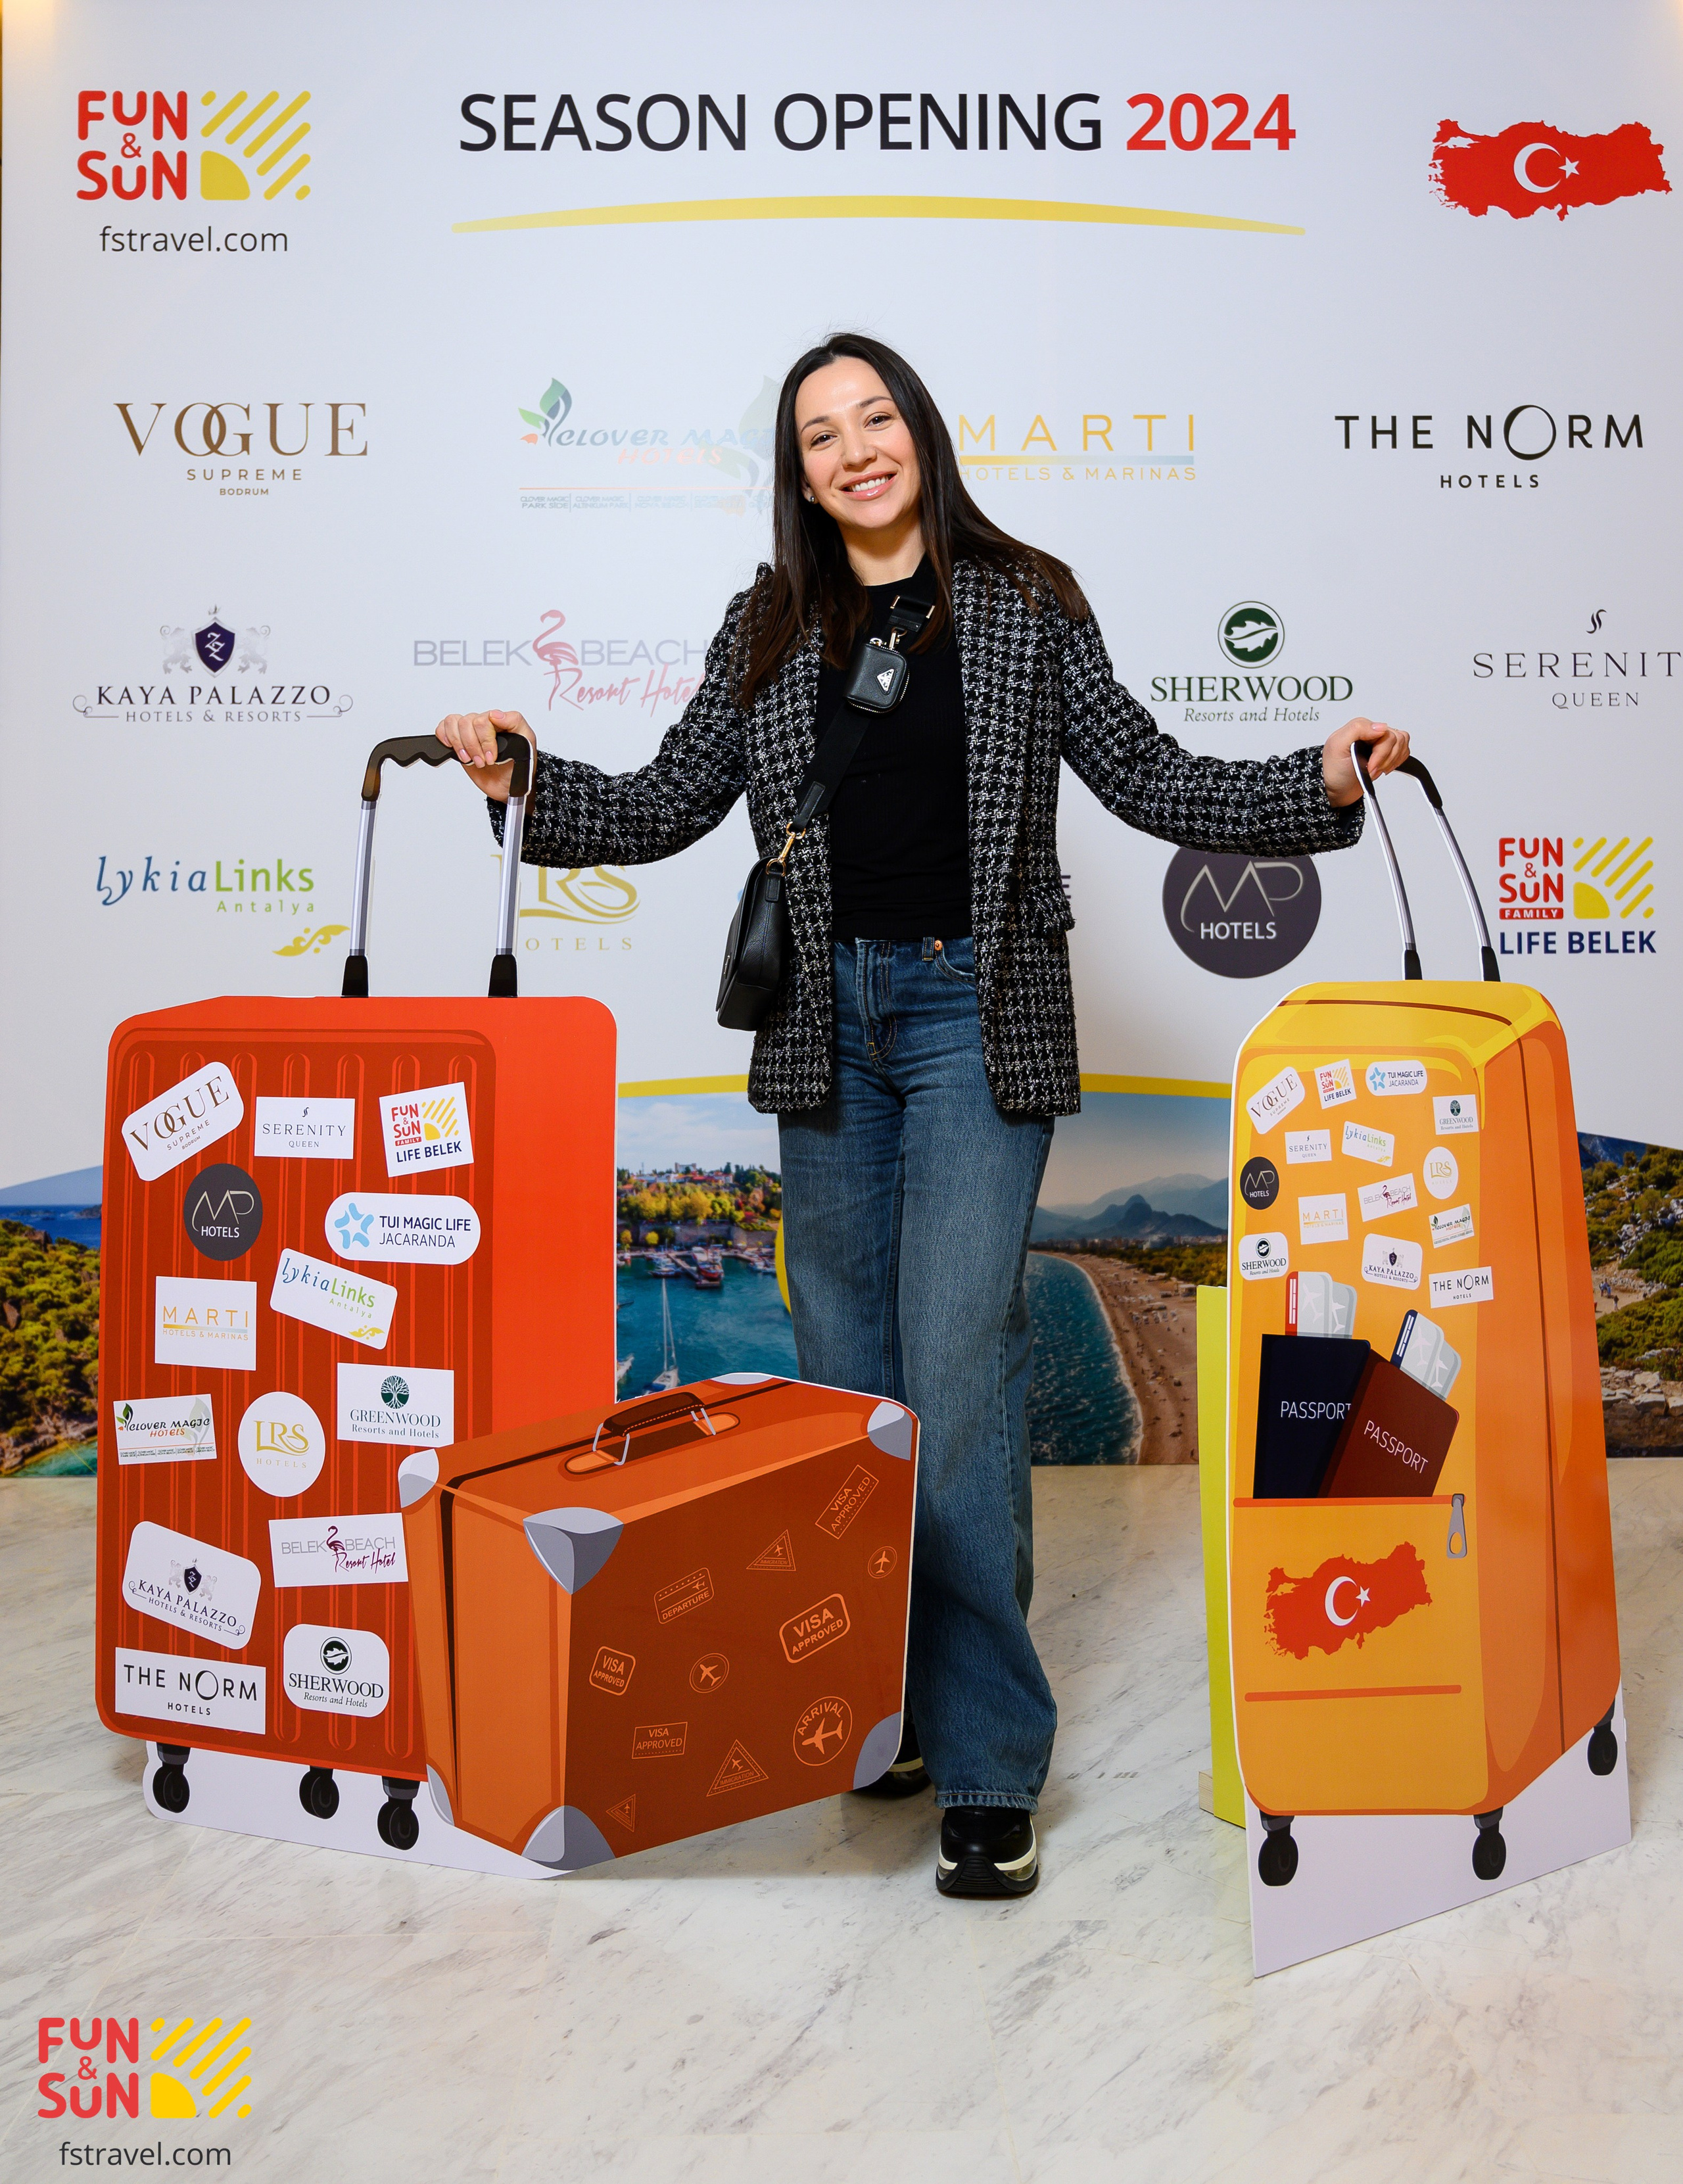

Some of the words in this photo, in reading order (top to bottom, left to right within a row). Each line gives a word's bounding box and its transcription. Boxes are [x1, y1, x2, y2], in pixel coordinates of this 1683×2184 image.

[77, 90, 188, 141] FUN
[460, 93, 746, 152] SEASON
[774, 93, 1102, 152] OPENING
[1126, 93, 1296, 152] 2024
[120, 132, 142, 159] &
[76, 150, 188, 201] SUN
[99, 226, 289, 252] fstravel.com
[114, 402, 368, 456] VOGUE
[556, 429, 669, 446] CLOVER
[959, 414, 1195, 452] MARTI
[1335, 415, 1433, 449] THE
[1467, 404, 1644, 460] NORM
[617, 447, 723, 466] HOTELS
[186, 469, 302, 481] SUPREME
[957, 467, 1051, 481] HOTELS
[1062, 467, 1076, 481] &
[1085, 467, 1197, 481] MARINAS
[1440, 474, 1539, 488] HOTELS
[219, 488, 270, 496] BODRUM
[414, 640, 533, 667] BELEK
[581, 640, 708, 667] BEACH
[1473, 652, 1682, 678] SERENIT
[97, 686, 177, 705] KAYA
[189, 685, 331, 705] PALAZZO
[544, 667, 640, 711] Resort
[1150, 676, 1354, 702] SHERWOOD
[1552, 692, 1639, 710] QUEEN
[126, 711, 193, 723] HOTELS
[202, 709, 215, 723] &
[225, 711, 302, 723] RESORTS
[1183, 707, 1233, 723] Resorts
[1239, 707, 1268, 722] and
[1273, 707, 1319, 723] Hotels
[1498, 837, 1563, 868] FUN
[1524, 862, 1537, 878] &
[1180, 860, 1304, 934] MP
[1498, 872, 1563, 903] SUN
[216, 900, 314, 915] Antalya
[1504, 909, 1558, 919] FAMILY
[1200, 922, 1277, 941] HOTELS
[525, 938, 632, 951] OTELS
[1500, 932, 1557, 955] LIFE
[1567, 930, 1657, 954] BELEK
[1319, 1070, 1332, 1081] FUN
[1321, 1078, 1334, 1089] SUN
[1250, 1073, 1298, 1118] VOGUE
[1324, 1093, 1335, 1101] LIFE
[1335, 1088, 1352, 1098] BELEK
[130, 1075, 230, 1151] VOGUE
[391, 1103, 419, 1122] FUN
[1439, 1116, 1474, 1125] GREENWOOD
[167, 1119, 211, 1151] SUPREME
[262, 1124, 346, 1137] SERENITY
[393, 1120, 421, 1139] SUN
[181, 1135, 202, 1151] BODRUM
[289, 1140, 320, 1149] QUEEN
[396, 1137, 421, 1146] FAMILY
[1289, 1143, 1328, 1152] SERENITY
[396, 1148, 421, 1163] LIFE
[424, 1141, 463, 1158] BELEK
[1429, 1160, 1453, 1179] LRS
[1363, 1193, 1383, 1204] BELEK
[1390, 1185, 1411, 1197] BEACH
[192, 1189, 254, 1233] MP
[1302, 1208, 1344, 1222] MARTI
[201, 1225, 240, 1239] HOTELS
[379, 1215, 399, 1229] TUI
[403, 1216, 442, 1231] MAGIC
[445, 1218, 471, 1231] LIFE
[379, 1233, 456, 1248] JACARANDA
[1241, 1258, 1287, 1271] SHERWOOD
[1369, 1264, 1385, 1274] KAYA
[1386, 1268, 1414, 1279] PALAZZO
[1433, 1279, 1452, 1292] THE
[1456, 1274, 1489, 1291] NORM
[162, 1305, 249, 1328] MARTI
[328, 1297, 373, 1319] Antalya
[162, 1329, 197, 1338] HOTELS
[207, 1331, 249, 1341] MARINAS
[350, 1408, 441, 1428] GREENWOOD
[1280, 1400, 1352, 1420] PASSPORT
[130, 1421, 167, 1432] CLOVER
[149, 1428, 185, 1438] HOTELS
[352, 1423, 386, 1436] Resorts
[389, 1428, 406, 1436] and
[409, 1429, 439, 1438] Hotels
[253, 1420, 310, 1456] LRS
[1363, 1419, 1429, 1474] PASSPORT
[256, 1458, 307, 1469] HOTELS
[830, 1486, 853, 1513] VISA
[830, 1476, 871, 1532] APPROVED
[281, 1540, 326, 1554] BELEK
[344, 1536, 396, 1552] BEACH
[331, 1552, 369, 1573] Resort
[370, 1548, 396, 1574] Hotel
[138, 1579, 171, 1603] KAYA
[176, 1594, 237, 1628] PALAZZO
[661, 1590, 711, 1621] DEPARTURE
[148, 1596, 178, 1614] HOTELS
[180, 1609, 187, 1617] &
[189, 1613, 223, 1632] RESORTS
[793, 1608, 835, 1638] VISA
[792, 1619, 844, 1656] APPROVED
[602, 1655, 625, 1676] VISA
[124, 1664, 166, 1688] THE
[179, 1669, 257, 1701] NORM
[288, 1672, 385, 1699] SHERWOOD
[593, 1670, 625, 1688] APPROVED
[167, 1701, 211, 1717] HOTELS
[303, 1692, 328, 1703] Resorts
[329, 1695, 344, 1705] and
[345, 1697, 368, 1708] Hotels
[797, 1701, 844, 1736] ARRIVAL
[648, 1727, 669, 1738] VISA
[635, 1737, 682, 1751] APPROVED
